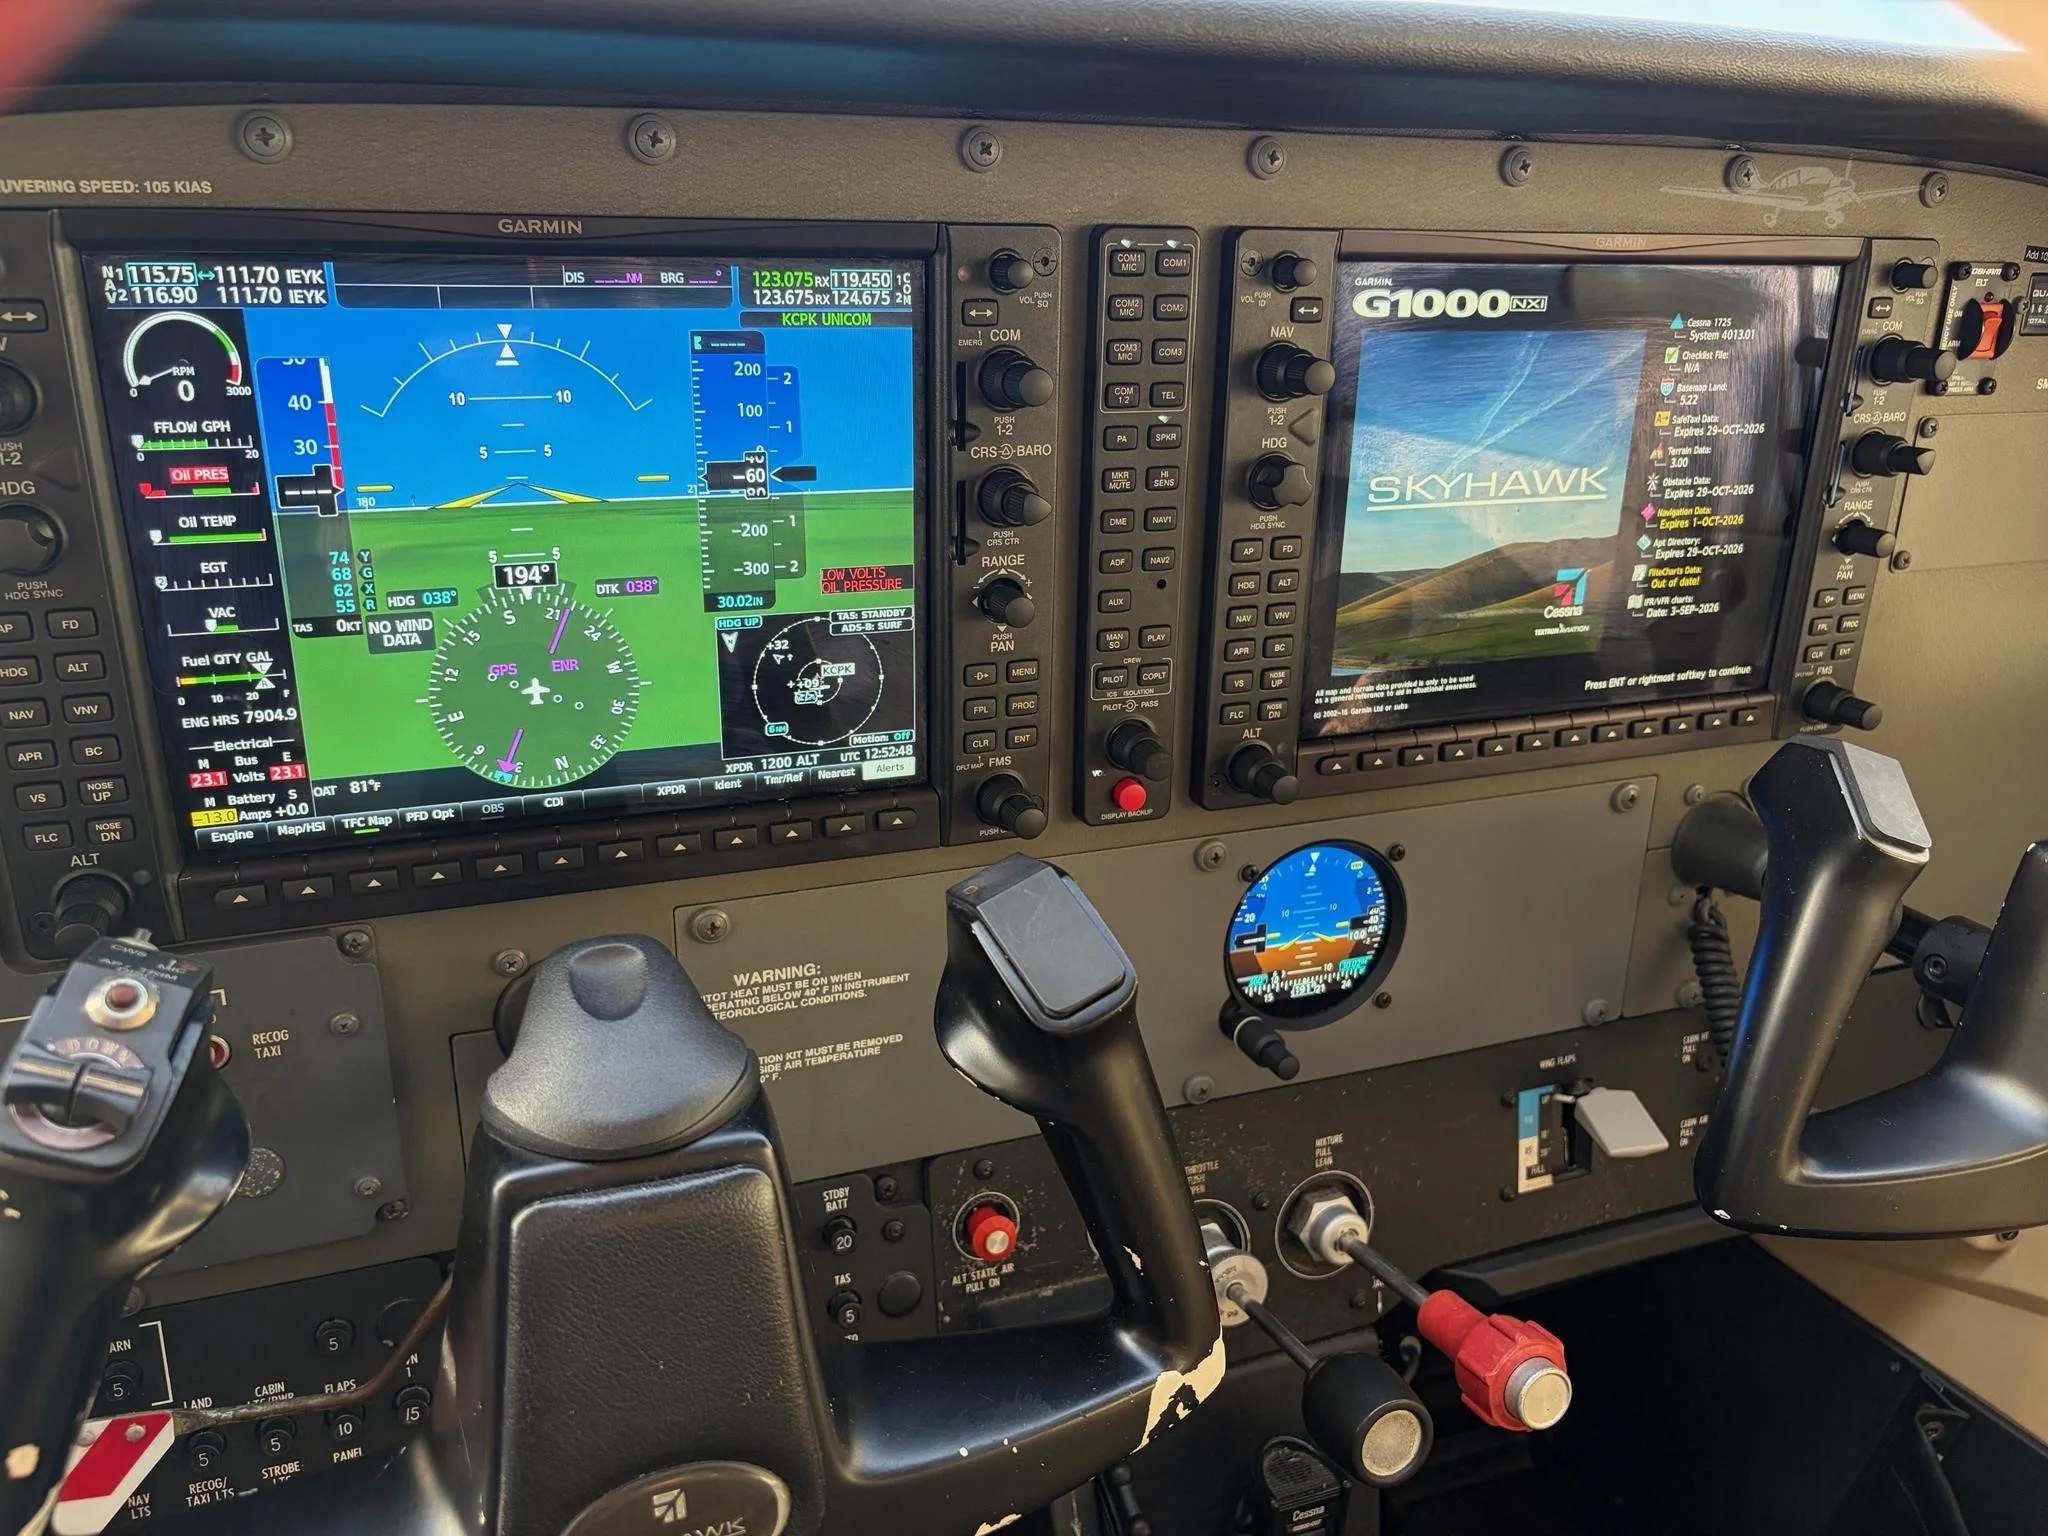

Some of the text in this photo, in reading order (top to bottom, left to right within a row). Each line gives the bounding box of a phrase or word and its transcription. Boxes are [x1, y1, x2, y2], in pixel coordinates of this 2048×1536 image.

[0, 180, 212, 194] UVERING SPEED: 105 KIAS
[498, 219, 582, 234] GARMIN
[1595, 236, 1648, 249] GARMIN
[1117, 254, 1141, 264] COM1
[1163, 258, 1187, 268] COM1
[129, 266, 194, 283] 115.75
[214, 267, 279, 283] 111.70
[752, 271, 891, 288] 123.075 119.450
[131, 287, 198, 304] 116.90
[216, 286, 282, 303] 111.70
[753, 289, 890, 306] 123.675 124.675
[1115, 299, 1139, 309] COM2
[1352, 289, 1510, 319] G1000
[782, 311, 872, 327] KCPK UNICOM
[990, 329, 1021, 342] COM
[1270, 327, 1295, 338] NAV
[1689, 329, 1755, 343] System 4013.01
[172, 367, 195, 376] RPM
[734, 361, 761, 377] 200
[226, 386, 252, 396] 3000
[288, 395, 311, 410] 40
[154, 420, 231, 434] FFLOW GPH
[1155, 432, 1177, 442] SPKR
[1262, 437, 1287, 449] HDG
[970, 444, 1052, 458] CRS BARO
[172, 469, 229, 481] Oil PRES
[1662, 477, 1692, 486] Obstacle
[1367, 467, 1609, 503] SKYHAWK
[1664, 488, 1694, 500] Expires
[1844, 500, 1873, 511] RANGE
[178, 515, 236, 528] Oil TEMP
[1659, 518, 1689, 531] Expires
[329, 551, 349, 565] 74
[982, 554, 1025, 567] RANGE
[1655, 548, 1685, 560] Expires
[200, 561, 228, 573] EGT
[821, 566, 886, 580] LOW VOLTS
[822, 578, 902, 593] OIL PRESSURE
[1651, 578, 1666, 589] Out
[1668, 577, 1678, 588] of
[387, 594, 416, 607] HDG
[208, 607, 236, 618] VAC
[836, 608, 906, 620] TAS: STANDBY
[1543, 604, 1583, 619] Cessna
[1646, 607, 1668, 618] Date:
[368, 618, 433, 635] NO WIND
[841, 620, 903, 633] ADS-B: SURF
[383, 633, 422, 648] DATA
[990, 640, 1014, 652] PAN
[182, 651, 274, 667] Fuel QTY GAL
[551, 659, 580, 672] ENR
[488, 663, 518, 676] GPS
[1012, 666, 1036, 676] MENU
[1142, 671, 1166, 681] COPLT
[1102, 675, 1124, 685] PILOT
[1584, 665, 1752, 691] Press ENT or rightmost softkey to continue
[1011, 700, 1035, 711] PROC
[182, 708, 298, 729] ENG HRS 7904.9
[214, 737, 273, 752] Electrical
[852, 731, 911, 745] Motion: Off
[840, 745, 913, 763] UTC 12:52:48
[726, 753, 820, 774] XPDR 1200 ALT
[876, 762, 904, 774] Alerts
[989, 756, 1012, 768] FMS
[191, 773, 225, 787] 23.1
[233, 771, 265, 784] Volts
[764, 772, 803, 786] Tmr/Ref
[818, 767, 856, 780] Nearest
[313, 786, 338, 797] OAT
[657, 783, 687, 795] XPDR
[714, 778, 742, 791] Ident
[227, 791, 275, 807] Battery
[544, 796, 564, 808] CDI
[239, 808, 272, 821] Amps
[406, 808, 455, 822] PFD Opt
[481, 803, 505, 814] OBS
[1101, 809, 1154, 821] DISPLAY BACKUP
[278, 821, 326, 837] Map/HSI
[342, 815, 392, 829] TFC Map
[211, 829, 254, 844] Engine
[70, 853, 101, 867] ALT
[733, 963, 822, 987] WARNING:
[730, 971, 862, 1000] HEAT MUST BE ON WHEN
[763, 973, 911, 1005] BELOW INSTRUMENT
[800, 989, 868, 1007] CONDITIONS.
[252, 1029, 290, 1046] RECOG
[254, 1046, 282, 1059] TAXI
[786, 1033, 904, 1062] KIT MUST BE REMOVED
[784, 1046, 881, 1072] AIR TEMPERATURE
[823, 1186, 850, 1201] STDBY
[825, 1198, 849, 1213] BATT
[836, 1234, 852, 1249] 20
[834, 1272, 851, 1286] TAS
[255, 1381, 286, 1398] CABIN
[406, 1407, 420, 1421] 15
[338, 1422, 353, 1436] 10
[261, 1461, 301, 1480] STROBE
[189, 1476, 229, 1495] RECOG/
[128, 1493, 151, 1509] NAV
[186, 1488, 235, 1508] TAXI LTS
[1293, 1506, 1325, 1521] Cessna
